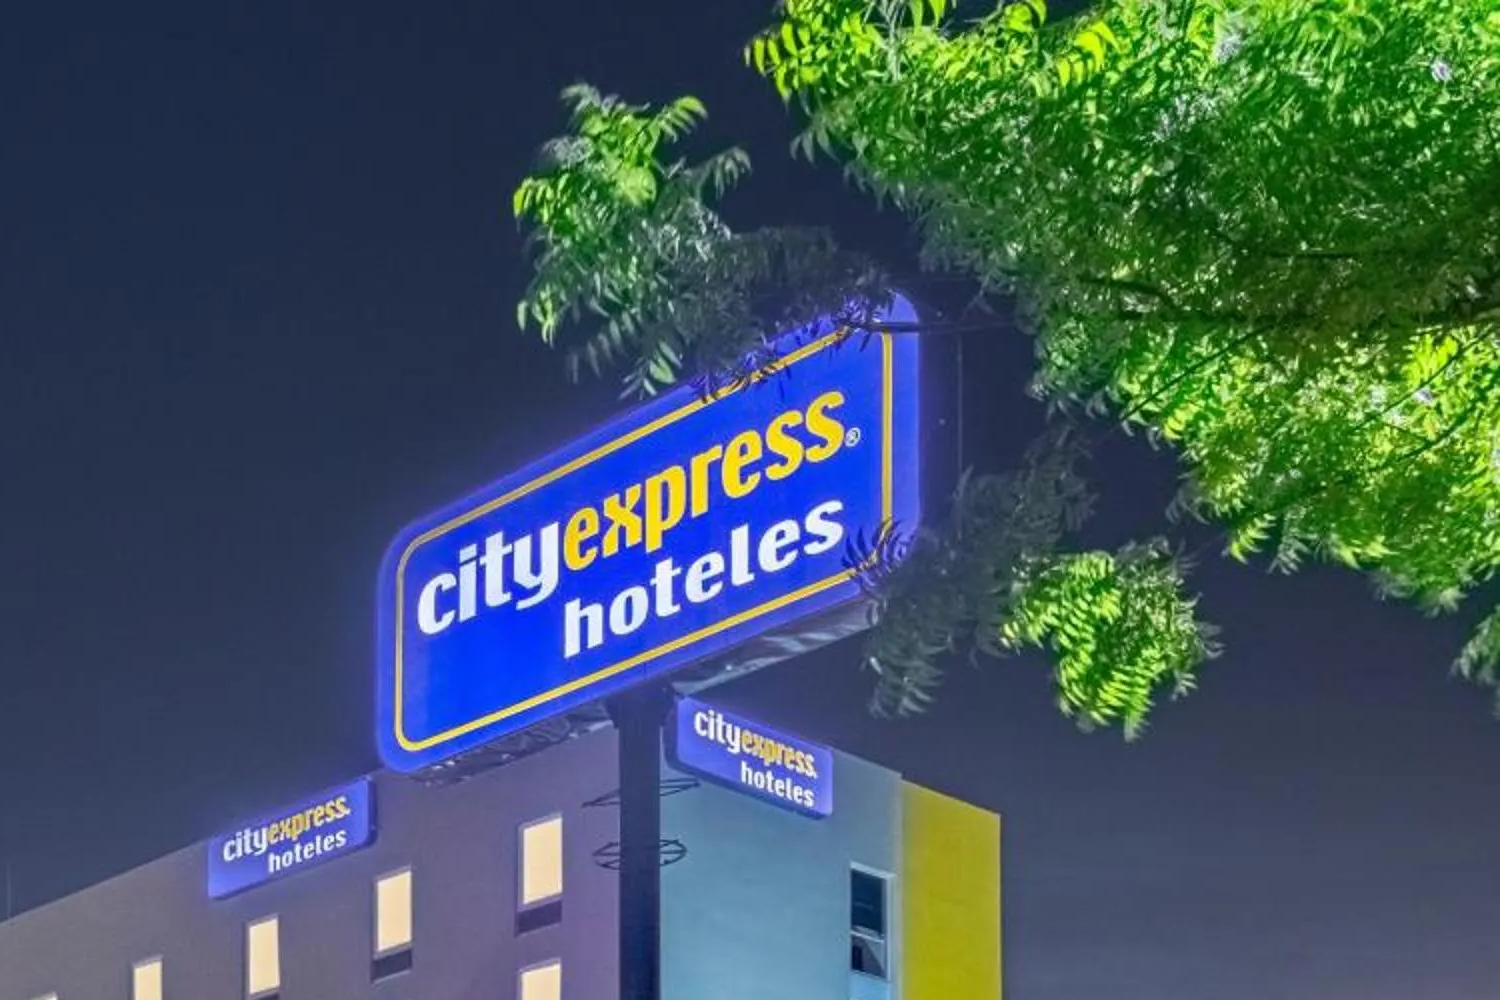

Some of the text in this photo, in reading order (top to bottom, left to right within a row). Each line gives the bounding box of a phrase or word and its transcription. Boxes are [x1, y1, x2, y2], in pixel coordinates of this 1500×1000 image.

[417, 390, 846, 637] cityexpress
[563, 500, 845, 659] hoteles
[740, 760, 815, 808] hoteles
[267, 829, 348, 873] hoteles
